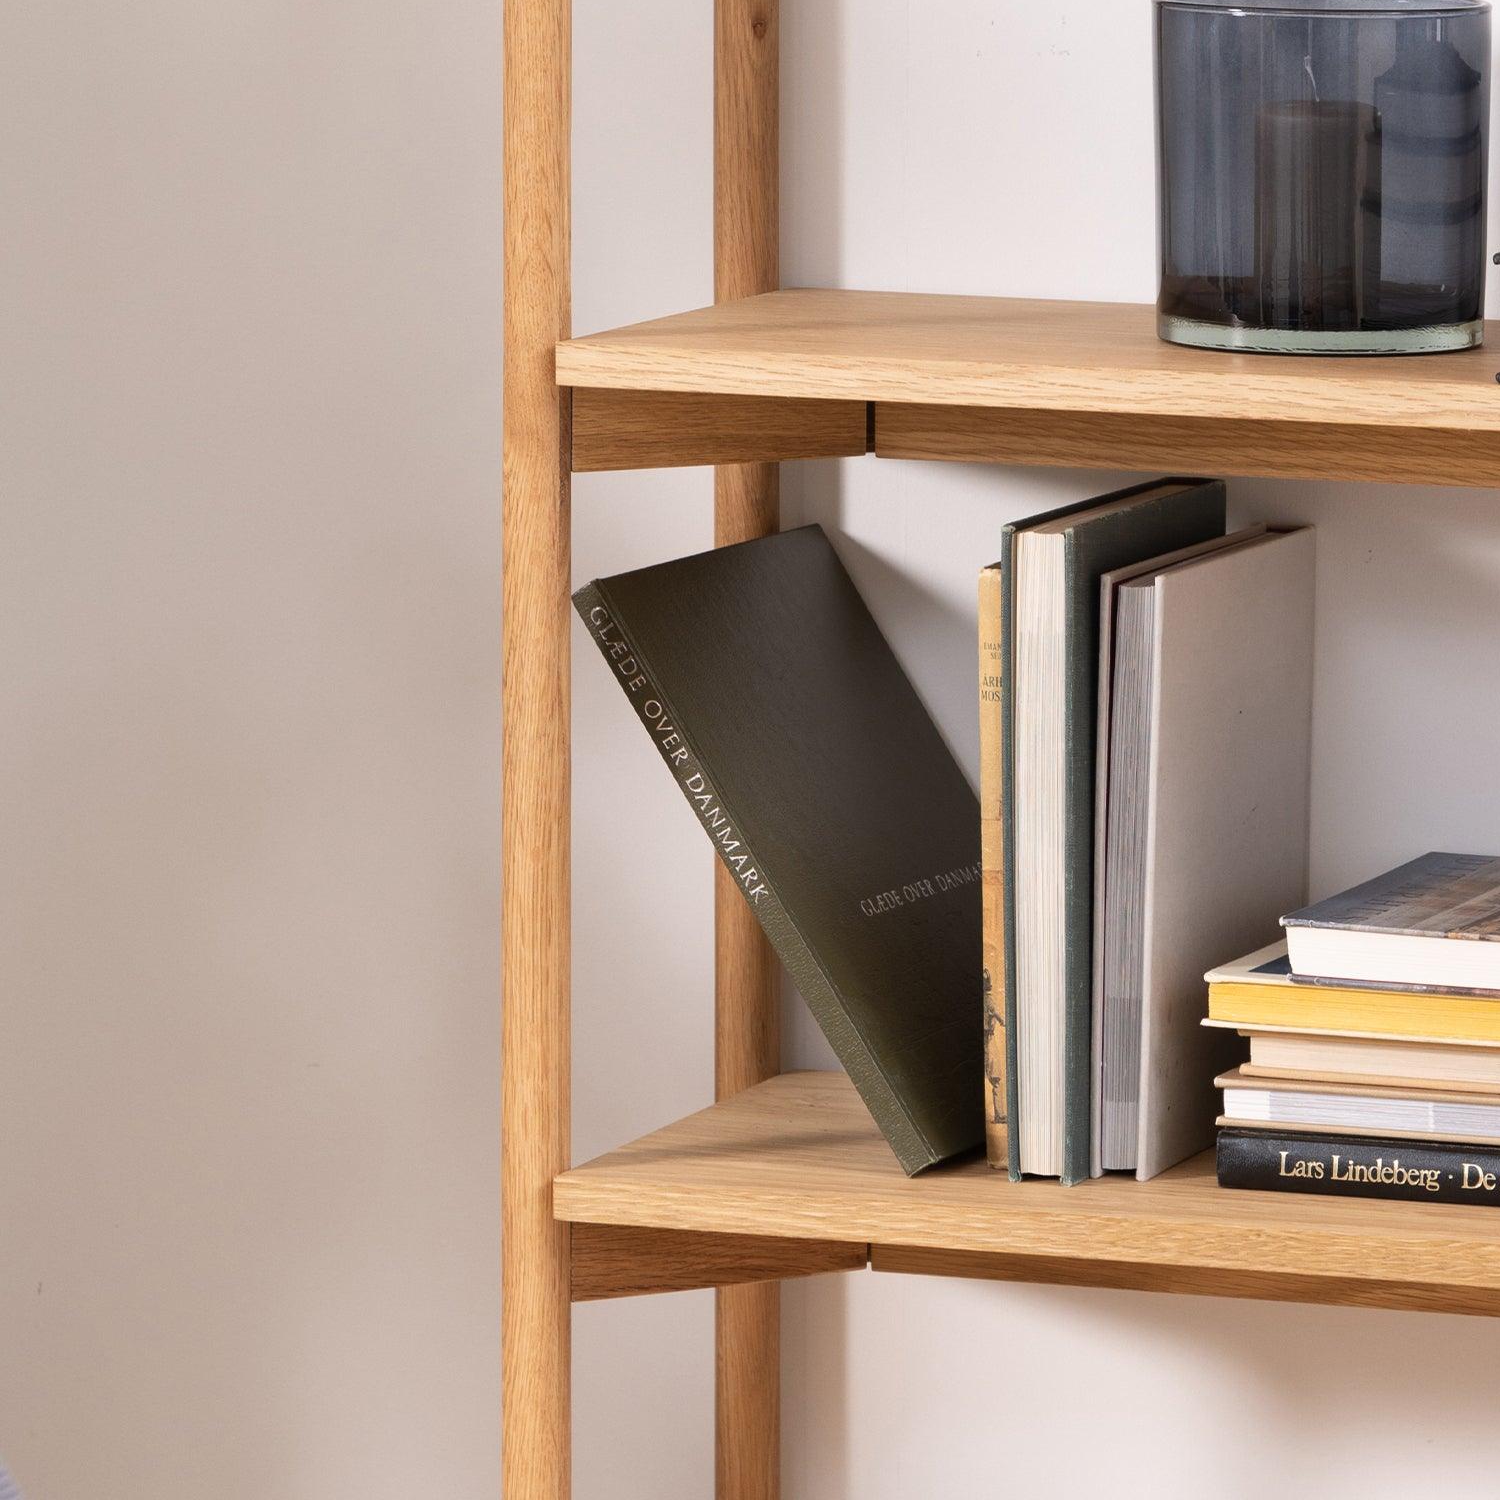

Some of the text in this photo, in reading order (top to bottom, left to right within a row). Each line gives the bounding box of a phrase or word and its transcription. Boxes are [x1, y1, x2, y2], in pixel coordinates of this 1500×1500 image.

[981, 690, 1002, 702] MOS
[983, 674, 1002, 688] ÅRH
[590, 606, 769, 903] GLÆDE OVER DANMARK
[860, 861, 983, 917] GLÆDE OVER DANMAR
[1278, 1151, 1325, 1179] Lars
[1331, 1154, 1440, 1192] Lindeberg
[1461, 1163, 1497, 1191] De
